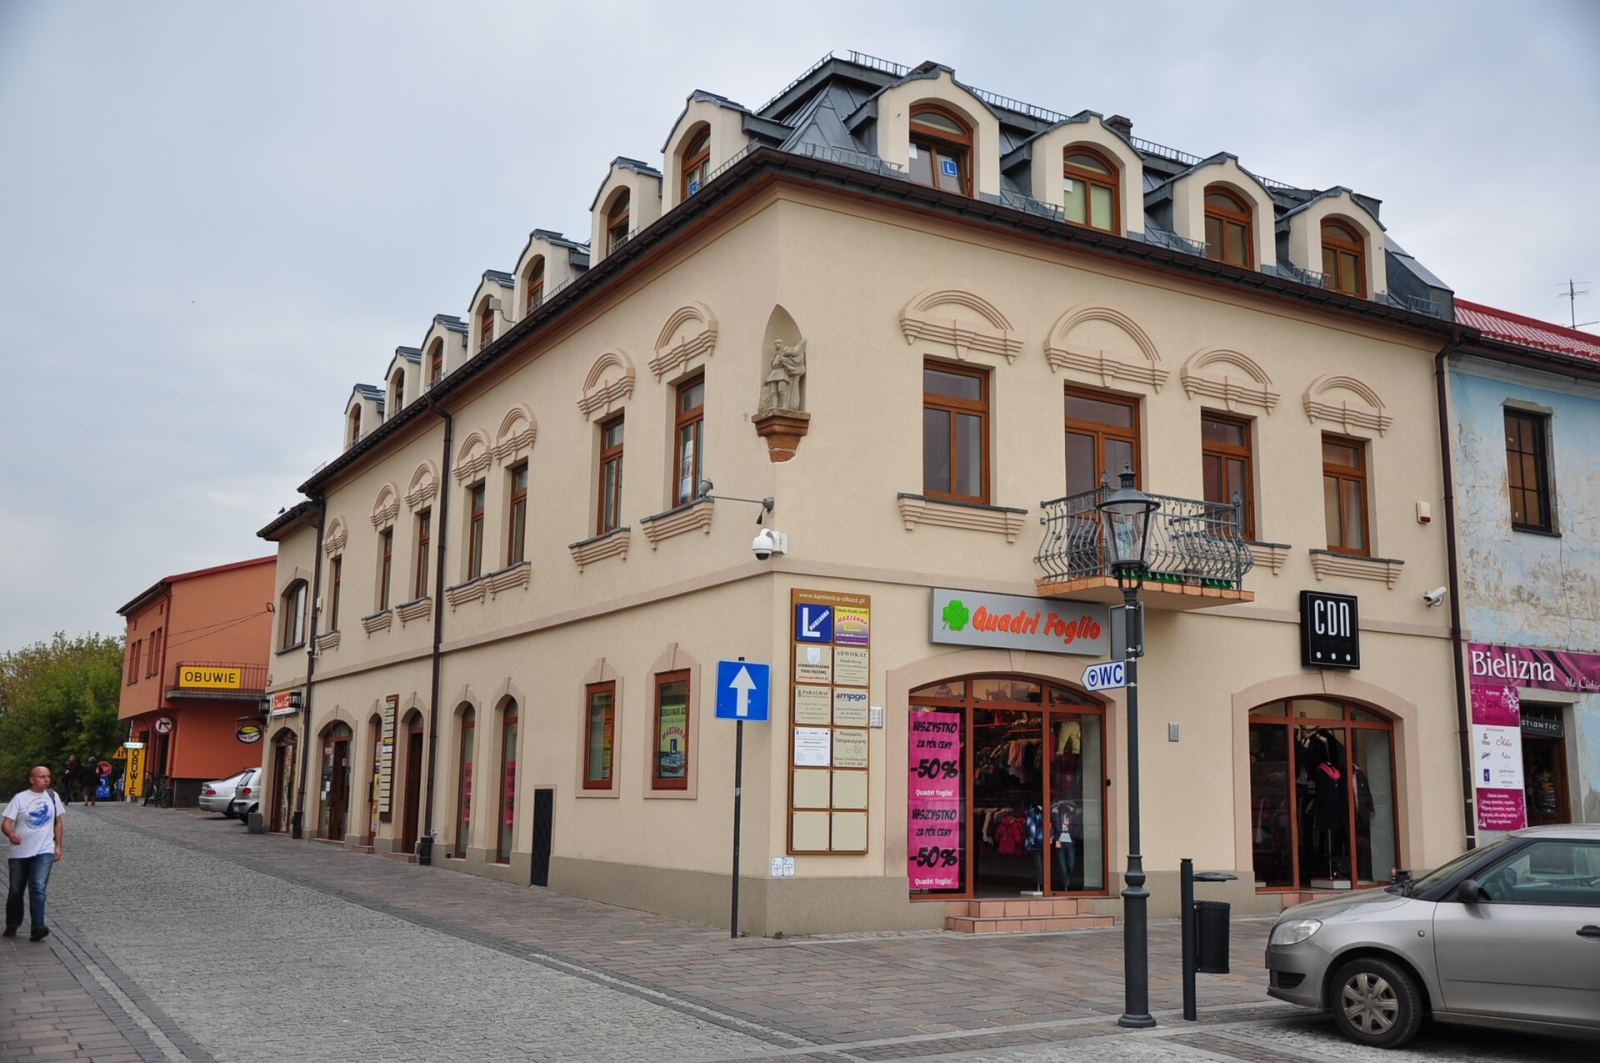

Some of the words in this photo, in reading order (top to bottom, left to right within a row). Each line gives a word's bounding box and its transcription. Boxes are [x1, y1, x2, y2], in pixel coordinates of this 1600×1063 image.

[972, 606, 1041, 635] Quadri
[1044, 613, 1101, 645] Foglio
[836, 650, 867, 658] ADWOKAT
[1471, 650, 1556, 682] Bielizna
[184, 671, 236, 684] OBUWIE
[1099, 664, 1124, 686] WC
[912, 721, 958, 734] WSZYSTKO
[938, 740, 953, 750] CENY
[129, 749, 140, 796] OBUWIE
[910, 758, 959, 780] -50%
[912, 808, 957, 821] WSZYSTKO
[936, 828, 952, 838] CENY
[909, 846, 958, 868] -50%
